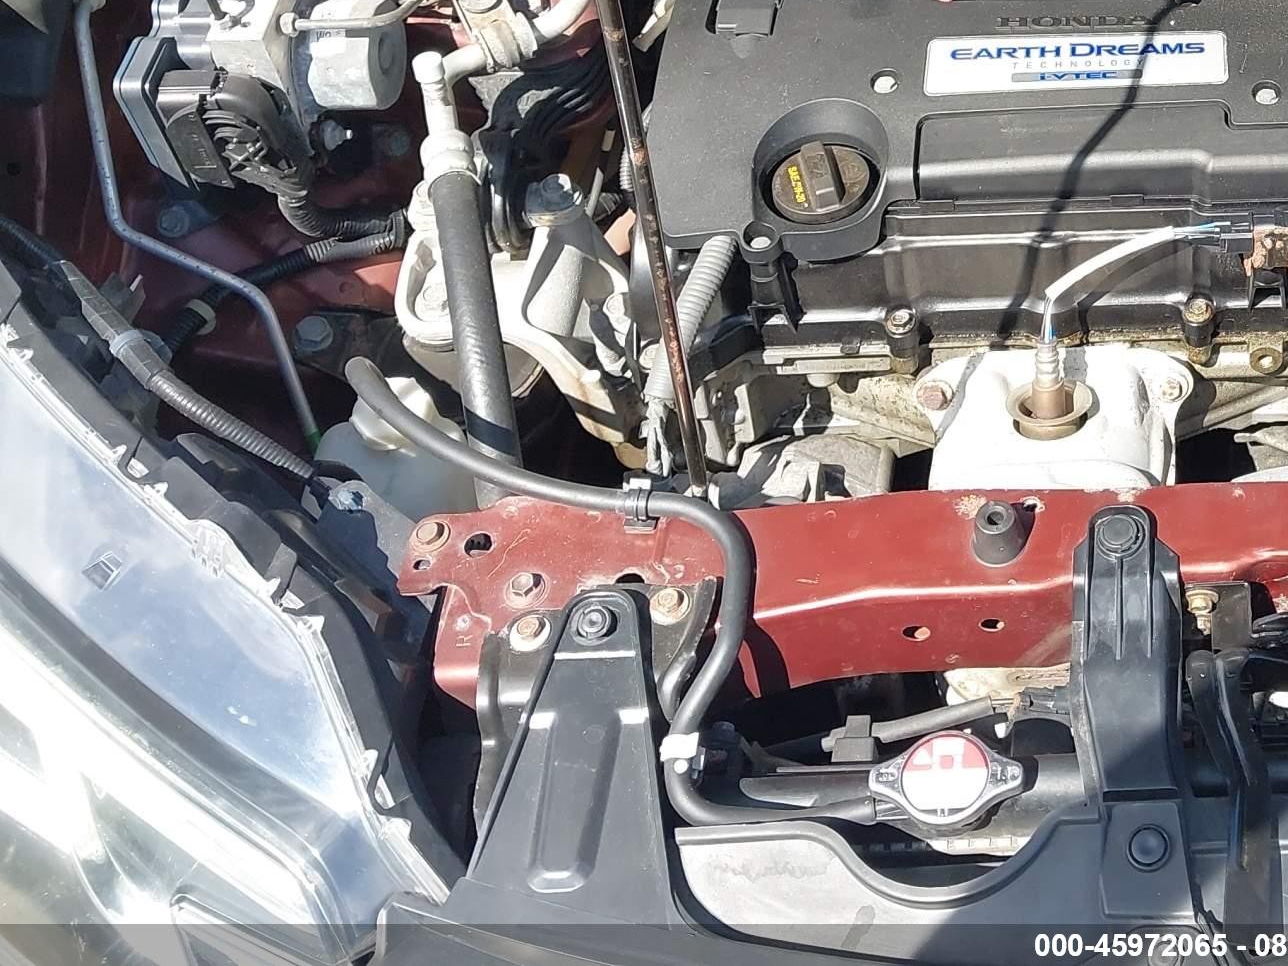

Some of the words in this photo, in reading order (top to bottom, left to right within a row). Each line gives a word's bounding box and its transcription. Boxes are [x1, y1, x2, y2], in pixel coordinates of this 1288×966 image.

[996, 15, 1157, 31] HONDA
[950, 46, 1062, 60] EARTH
[1069, 42, 1206, 57] DREAMS
[1012, 58, 1144, 69] TECHNOLOGY
